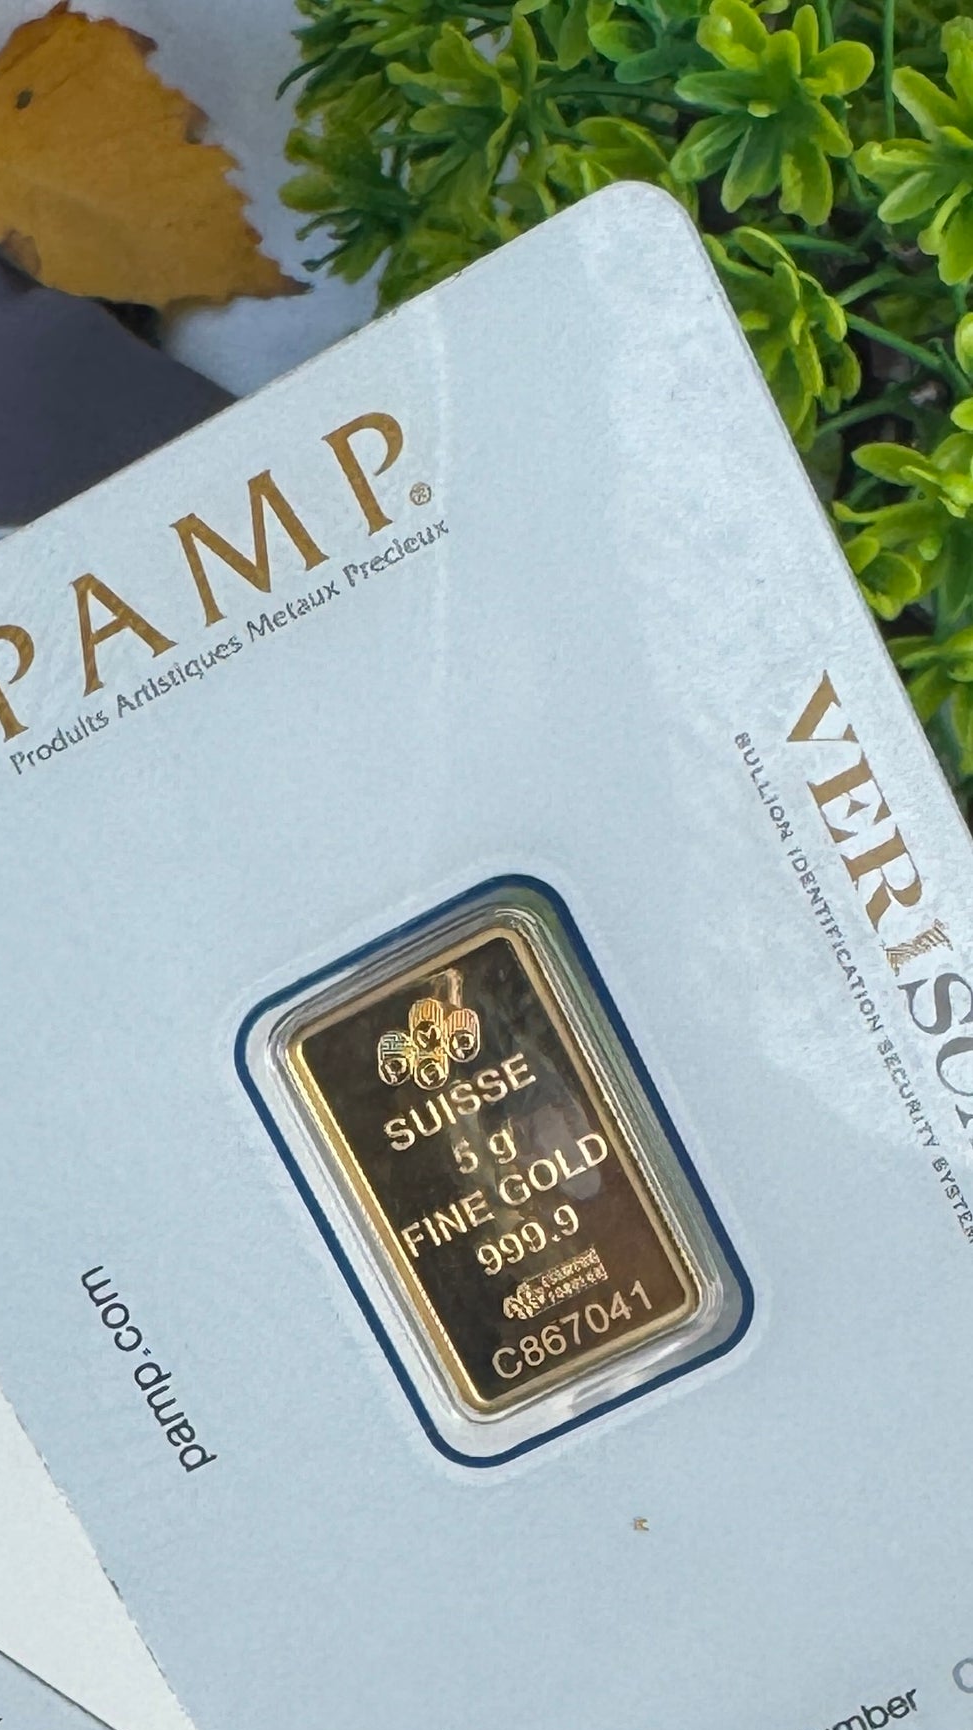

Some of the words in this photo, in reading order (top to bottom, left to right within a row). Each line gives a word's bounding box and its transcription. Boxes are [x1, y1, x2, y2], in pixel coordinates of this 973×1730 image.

[10, 707, 109, 775] Produits
[116, 634, 243, 718] Artistiques
[245, 580, 340, 643] Metaux
[343, 519, 450, 587] Precieux
[734, 731, 794, 842] BULLION
[786, 845, 884, 1033] IDENTIFICATION
[877, 1037, 940, 1147] SECURITY
[383, 1052, 536, 1152] SUISSE
[452, 1136, 478, 1175] 5
[489, 1120, 516, 1165] g
[401, 1190, 496, 1257] FINE
[500, 1132, 609, 1206] GOLD
[477, 1204, 580, 1276] 999.9
[81, 1265, 218, 1472] pamp.com
[492, 1280, 652, 1379] C867041
